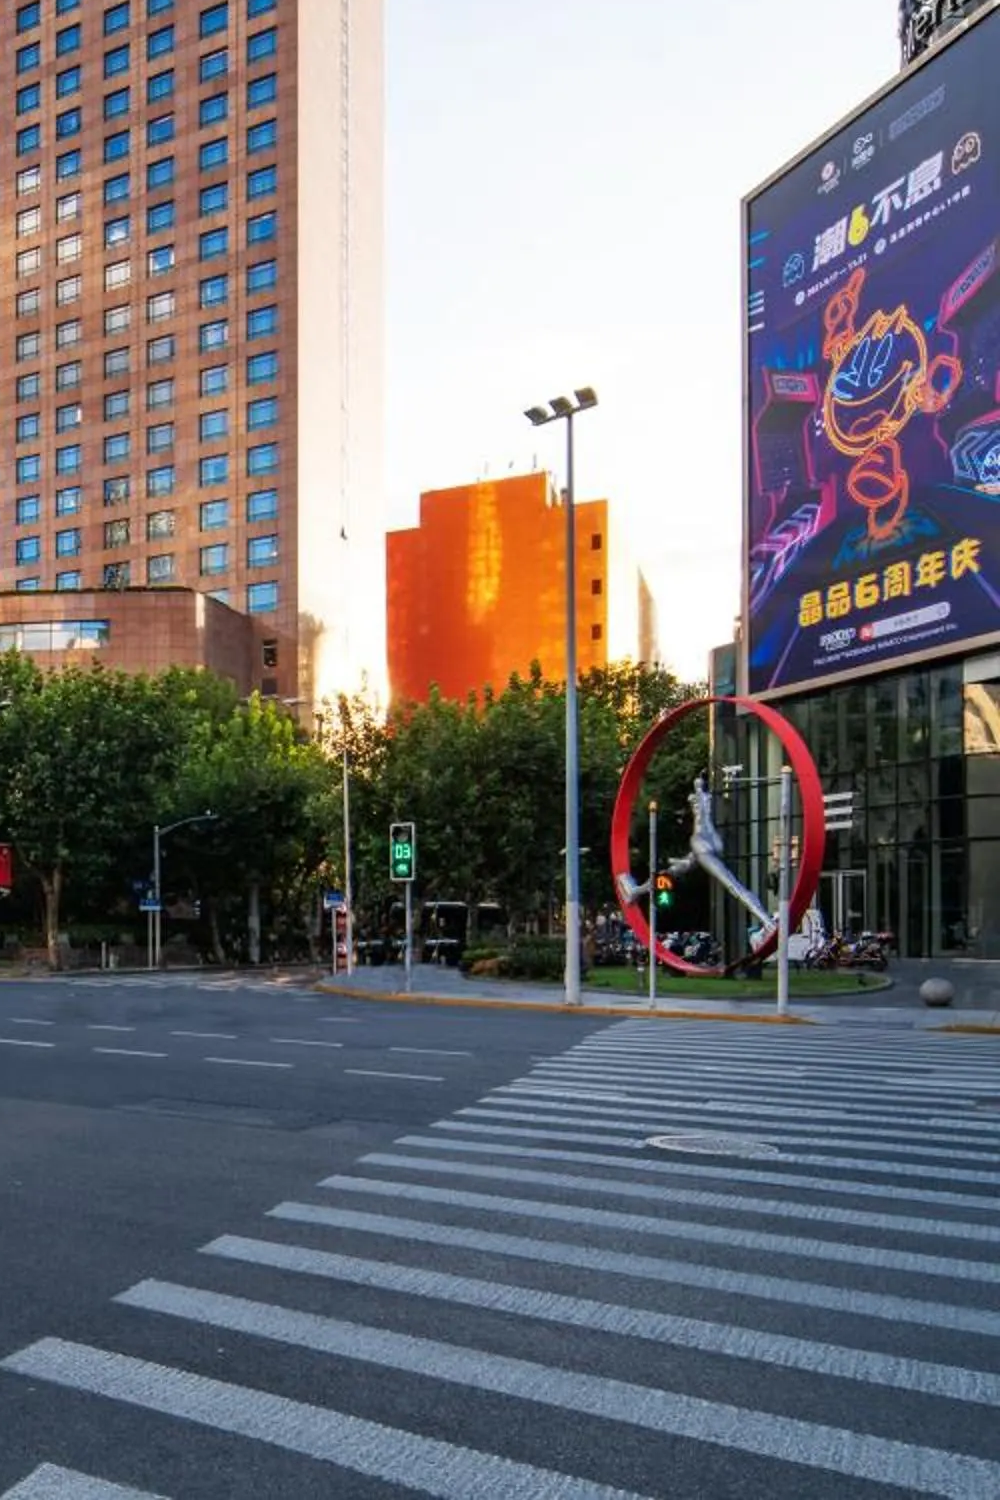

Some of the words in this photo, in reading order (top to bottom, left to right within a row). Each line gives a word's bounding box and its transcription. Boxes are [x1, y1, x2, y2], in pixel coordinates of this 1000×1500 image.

[798, 538, 982, 627] 晶品6周年庆
